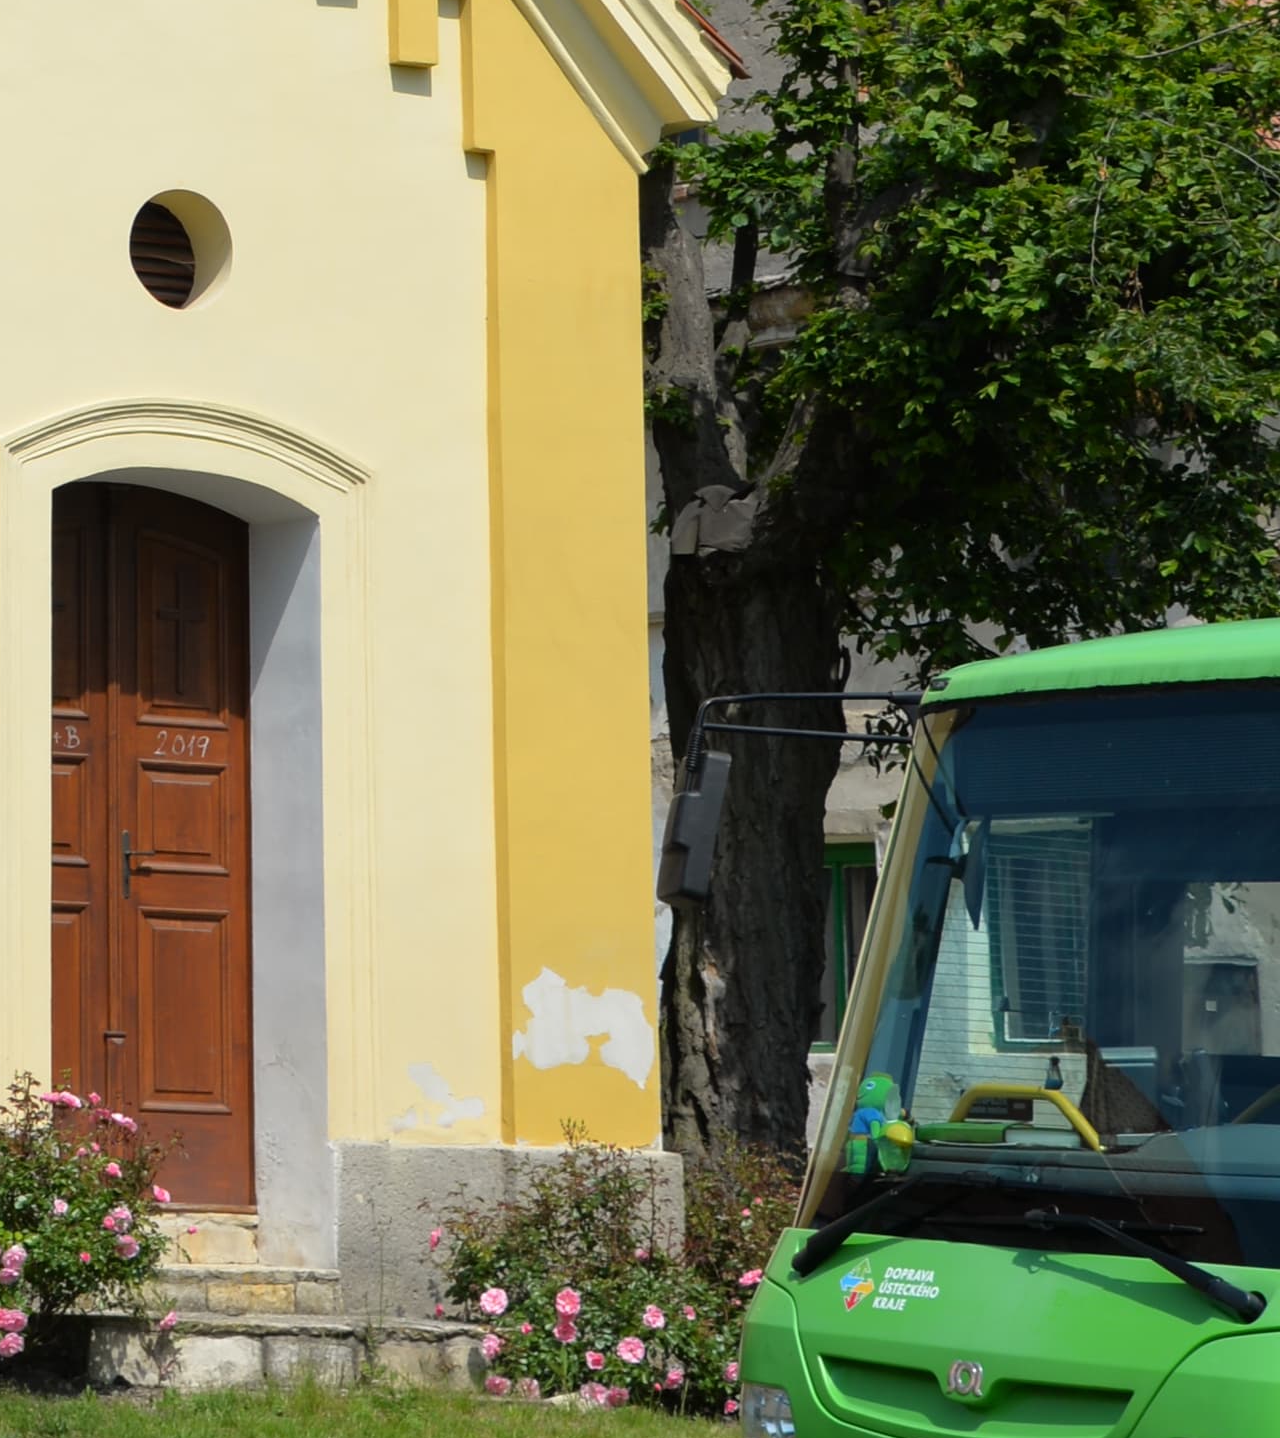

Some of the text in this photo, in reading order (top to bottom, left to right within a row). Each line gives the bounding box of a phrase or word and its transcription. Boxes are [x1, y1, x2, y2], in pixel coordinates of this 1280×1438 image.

[153, 730, 210, 758] 2019
[884, 1267, 935, 1283] DOPRAVA
[878, 1279, 940, 1299] ÚSTECKÉHO
[872, 1296, 907, 1311] KRAJE
